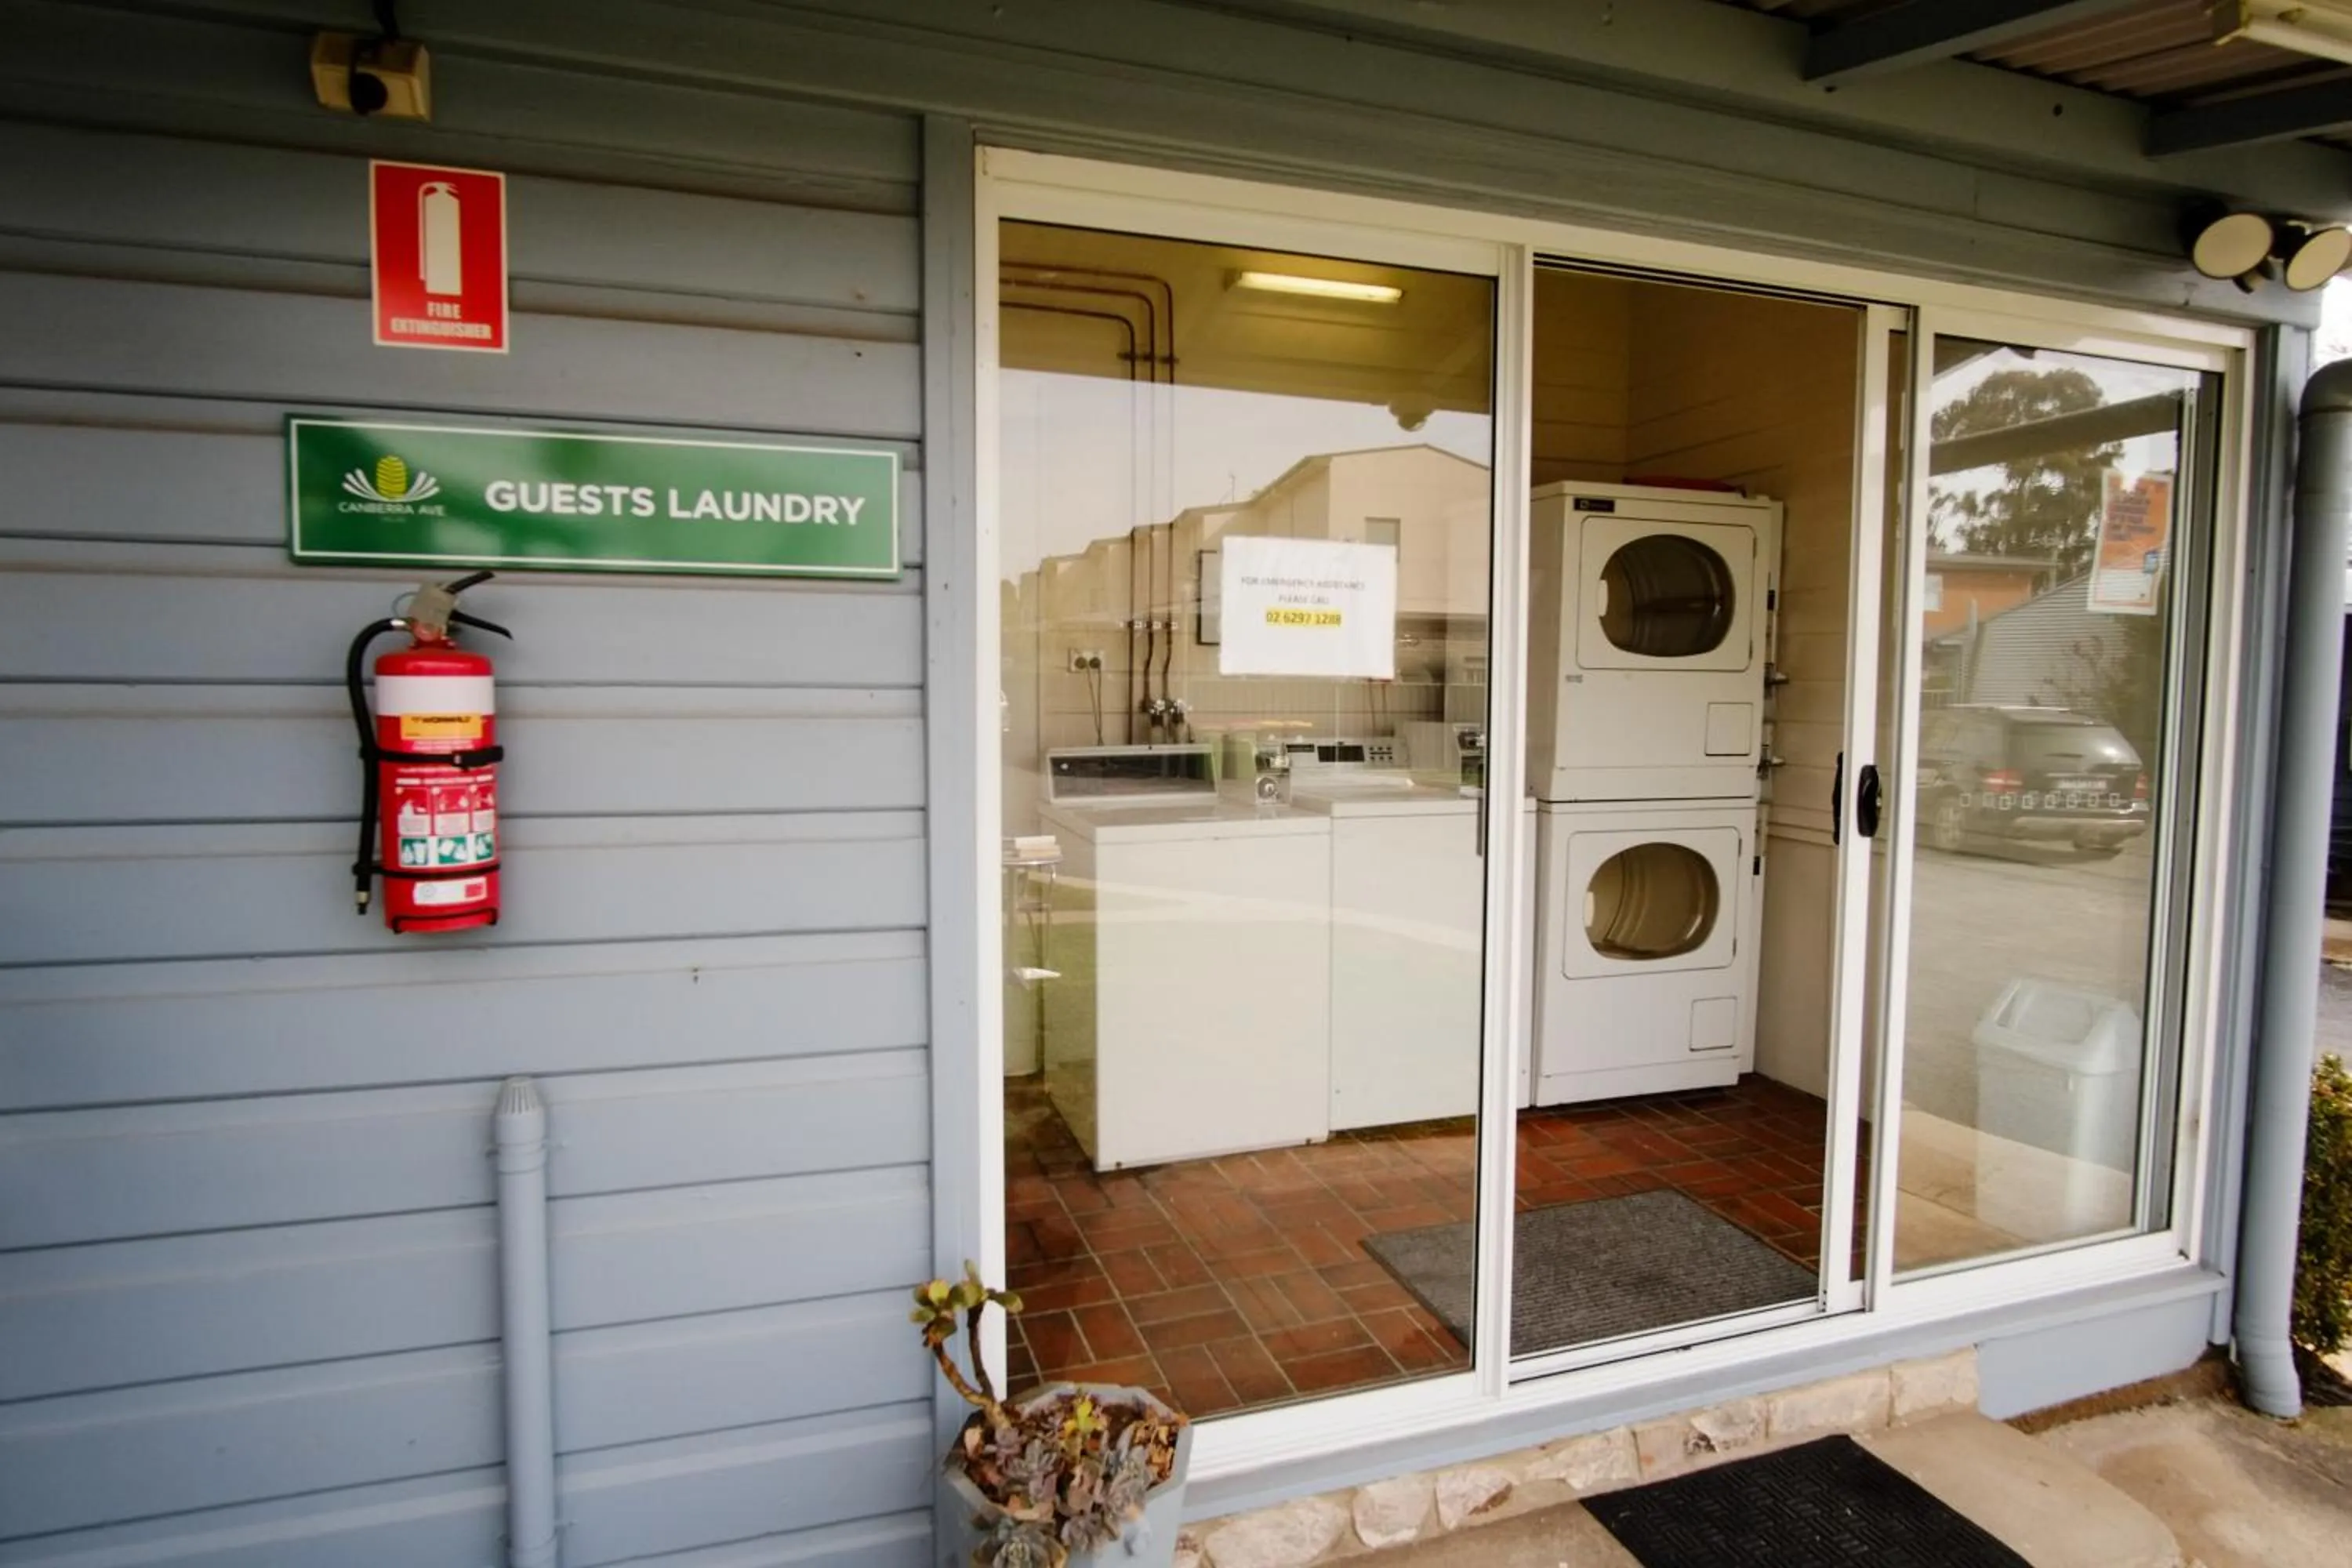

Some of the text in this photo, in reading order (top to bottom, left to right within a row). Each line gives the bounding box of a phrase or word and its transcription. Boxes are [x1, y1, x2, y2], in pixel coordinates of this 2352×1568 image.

[427, 301, 462, 319] FIRE
[485, 481, 866, 524] GUESTS LAUNDRY
[1266, 612, 1279, 623] 02
[1283, 612, 1312, 624] 6297
